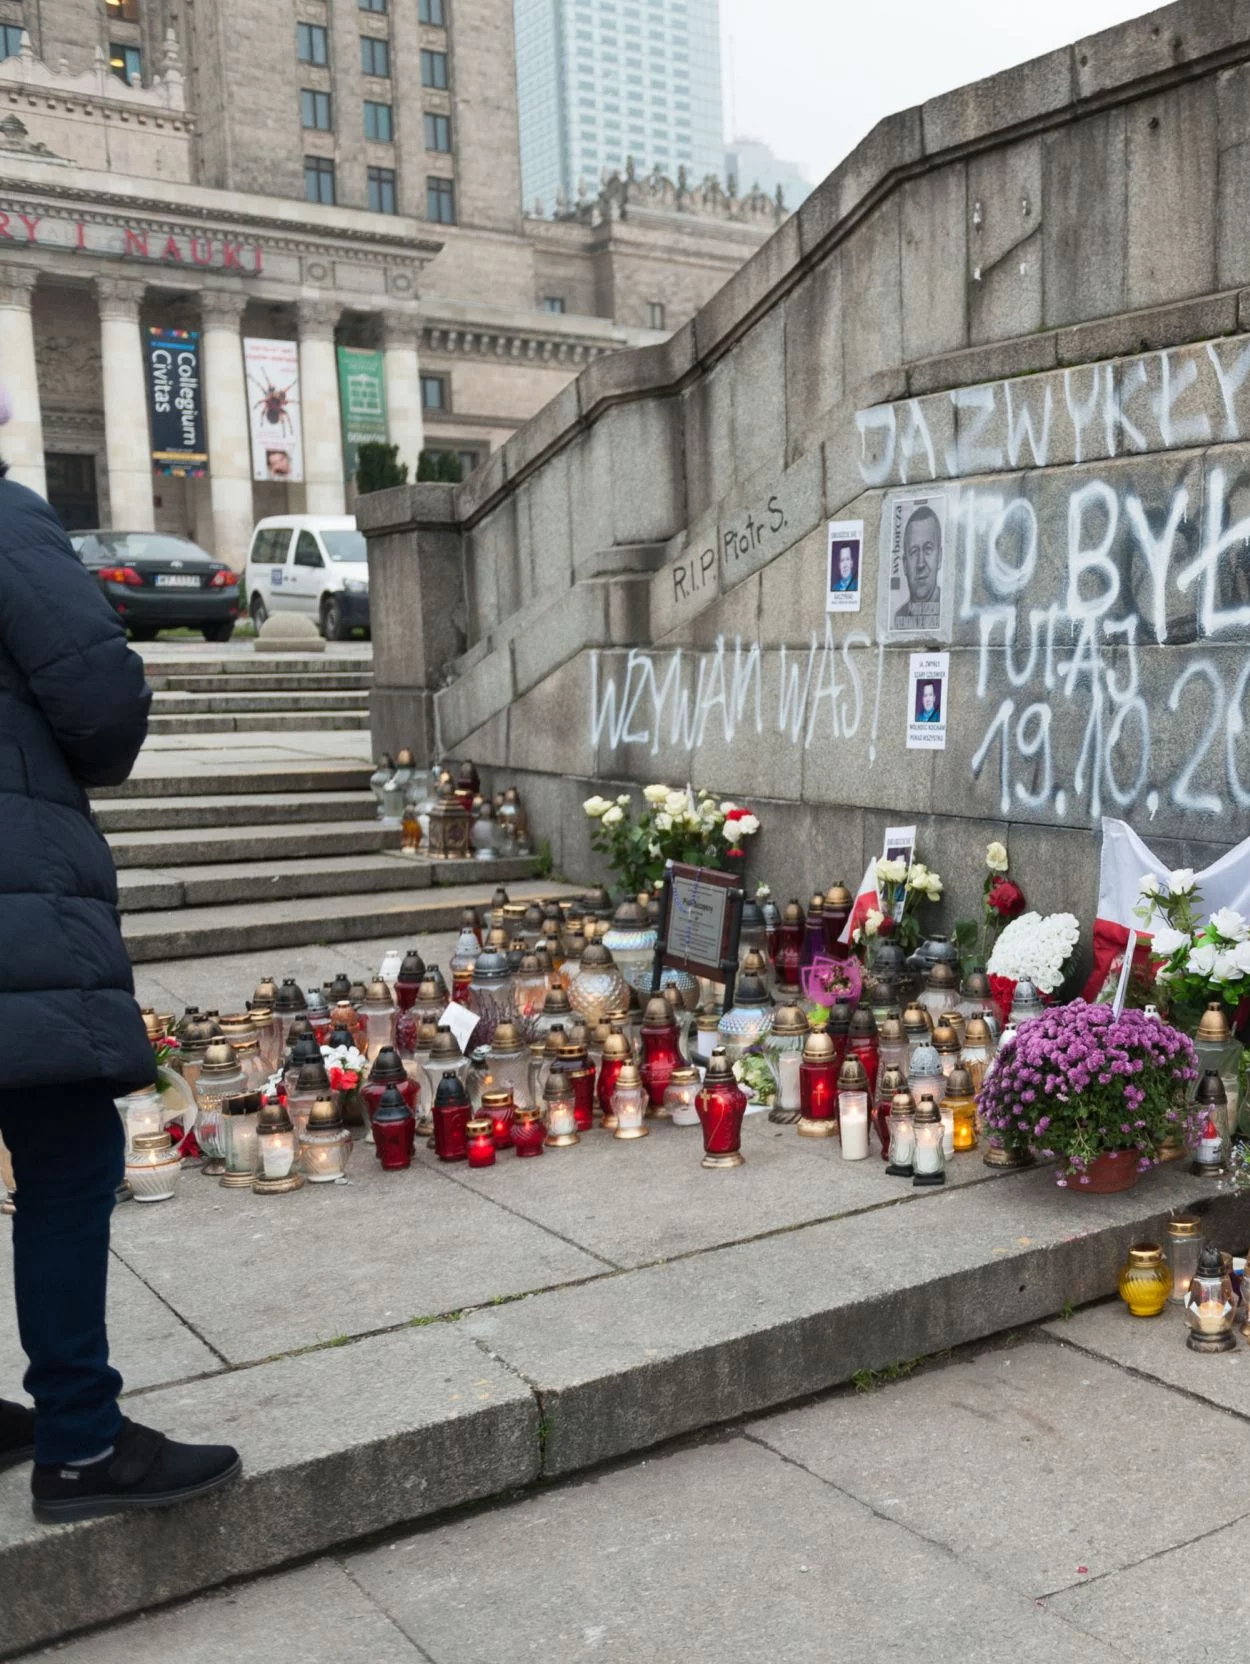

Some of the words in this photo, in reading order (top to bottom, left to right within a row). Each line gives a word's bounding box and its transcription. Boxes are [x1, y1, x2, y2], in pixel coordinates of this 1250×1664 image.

[77, 223, 86, 249] I
[124, 227, 262, 272] NAUKI
[152, 349, 173, 413] Civitas
[175, 352, 199, 446] Collegium
[855, 399, 937, 486] JA
[673, 549, 717, 603] R.I.P.
[723, 513, 764, 563] Piotr
[767, 496, 788, 532] S.
[952, 488, 1039, 618] TO
[977, 606, 1140, 700] TUTAJ
